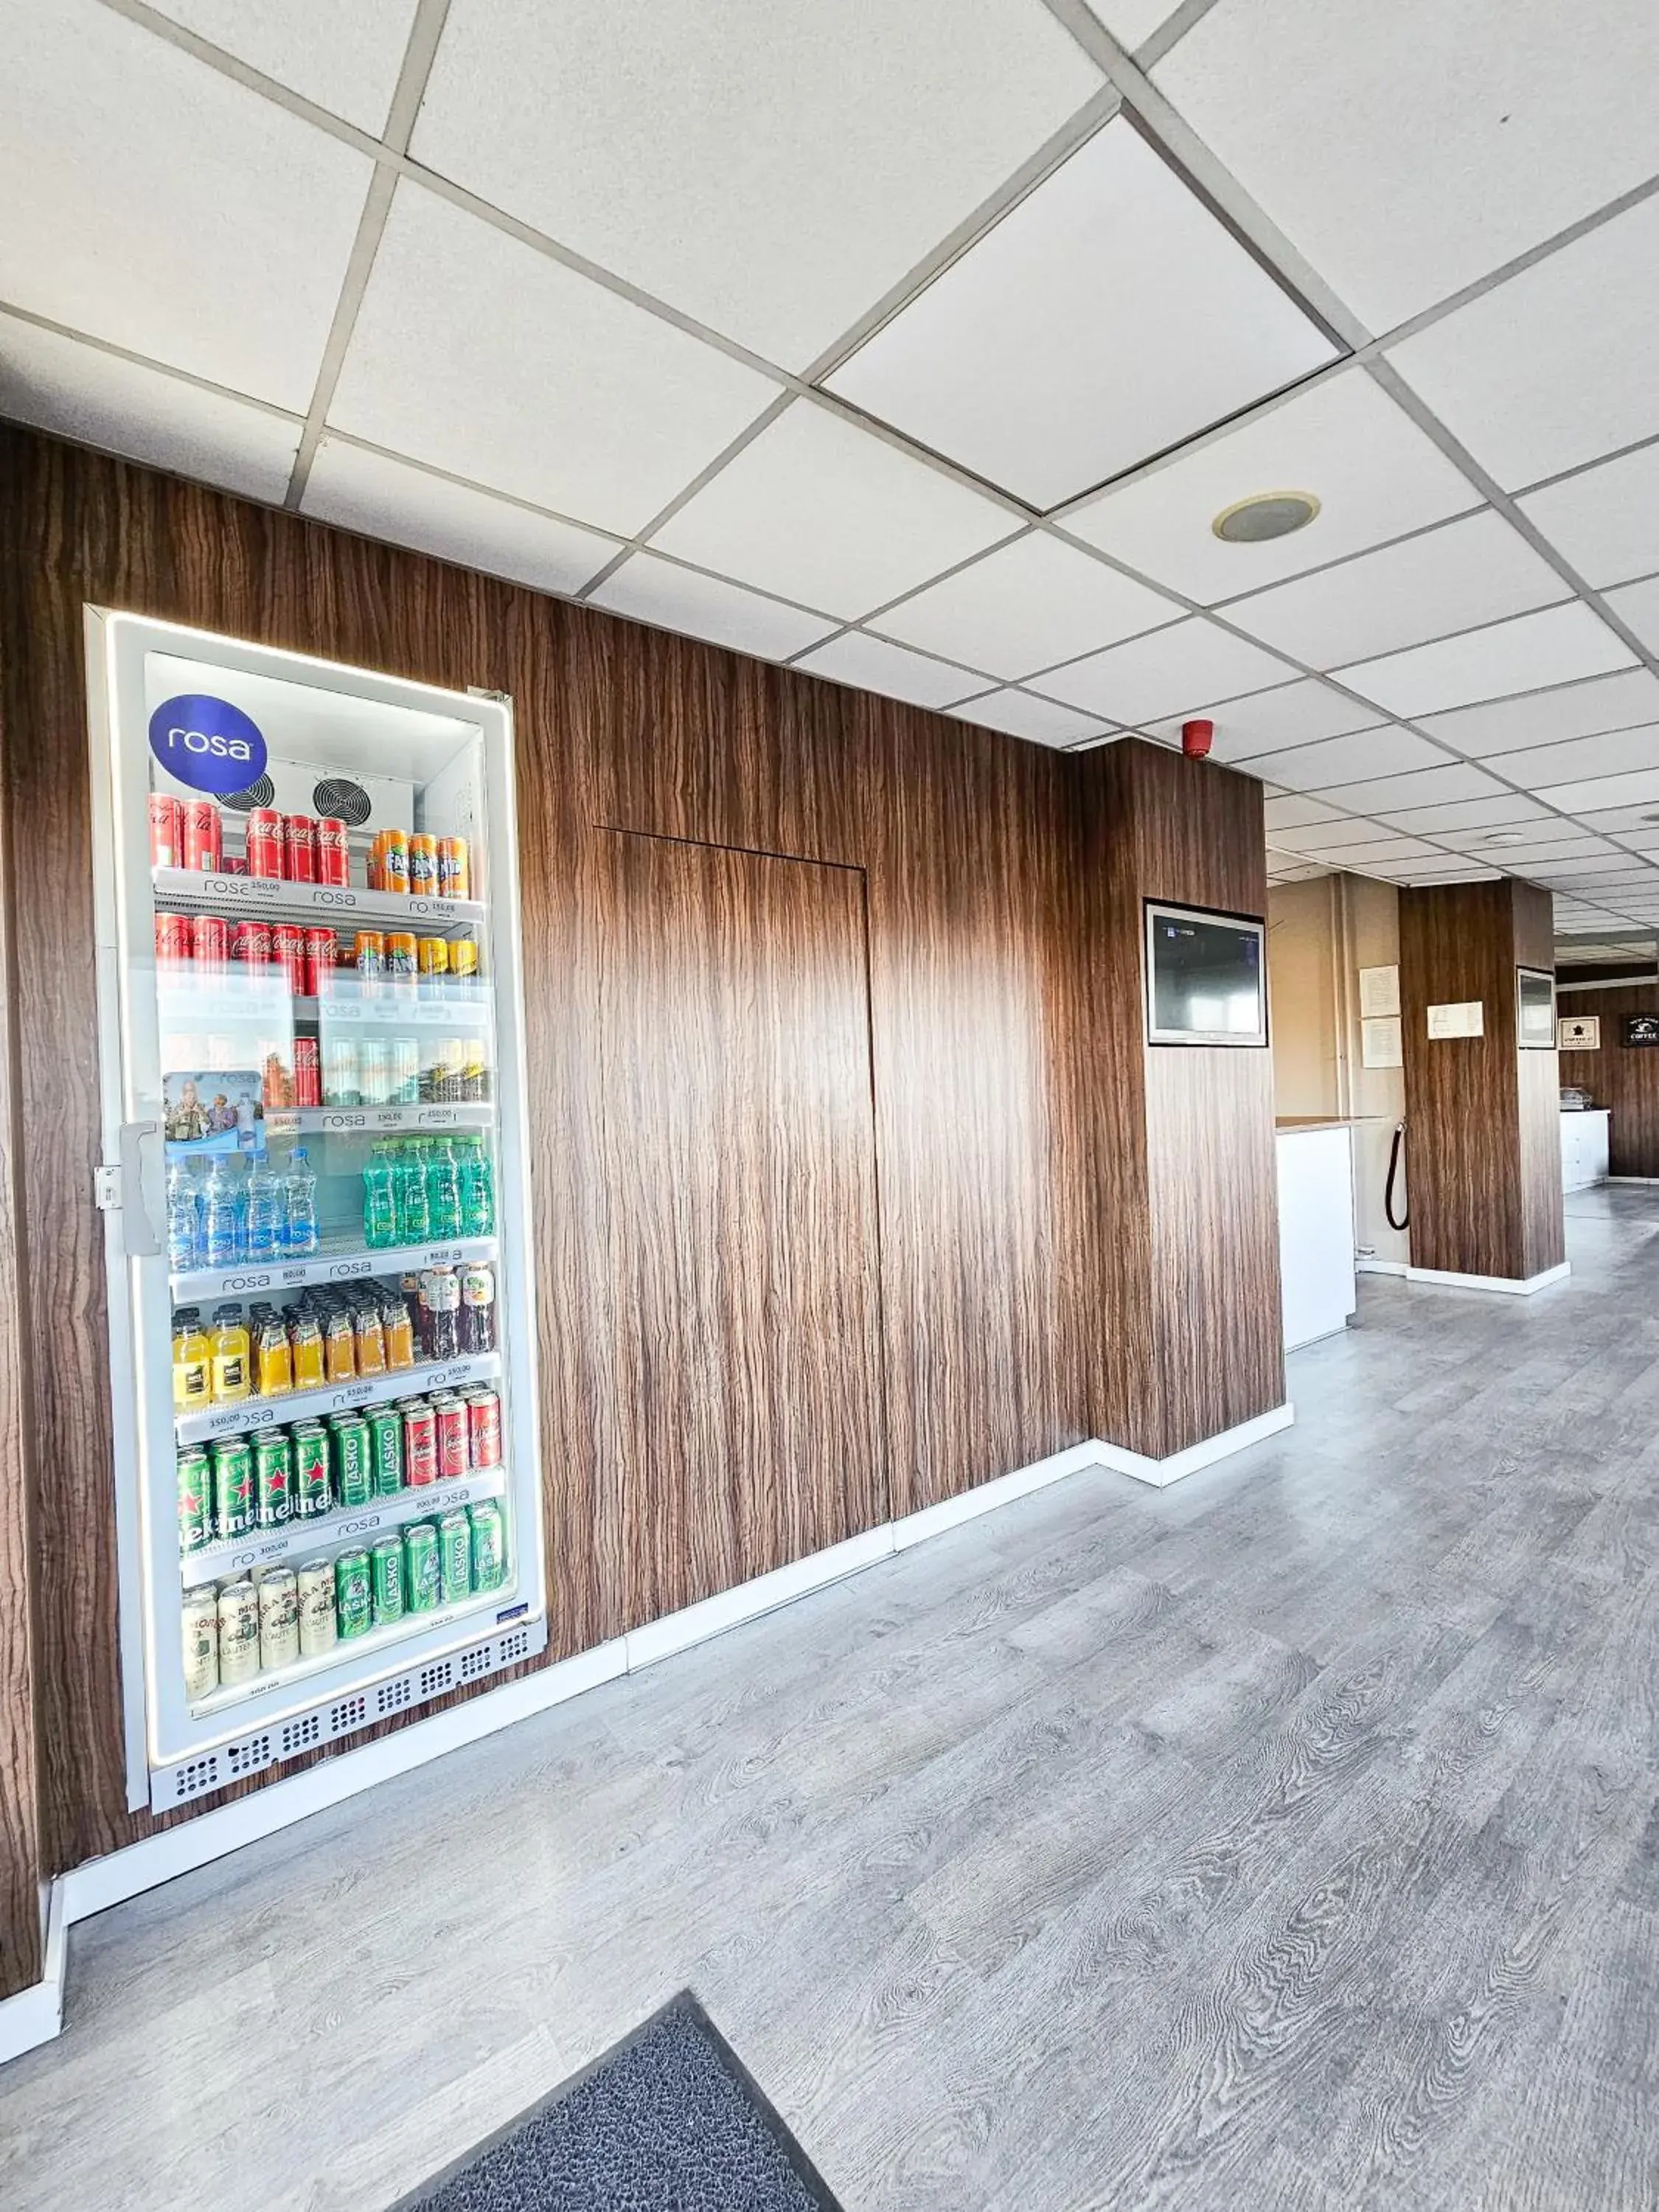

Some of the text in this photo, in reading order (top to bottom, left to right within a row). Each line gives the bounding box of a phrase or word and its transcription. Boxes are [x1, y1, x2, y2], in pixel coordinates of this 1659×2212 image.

[168, 728, 250, 761] rosa
[313, 891, 356, 906] rosa
[322, 1114, 366, 1127] rosa
[330, 1262, 372, 1276] rosa
[222, 1275, 271, 1291] rosa
[338, 1515, 380, 1536] rosa
